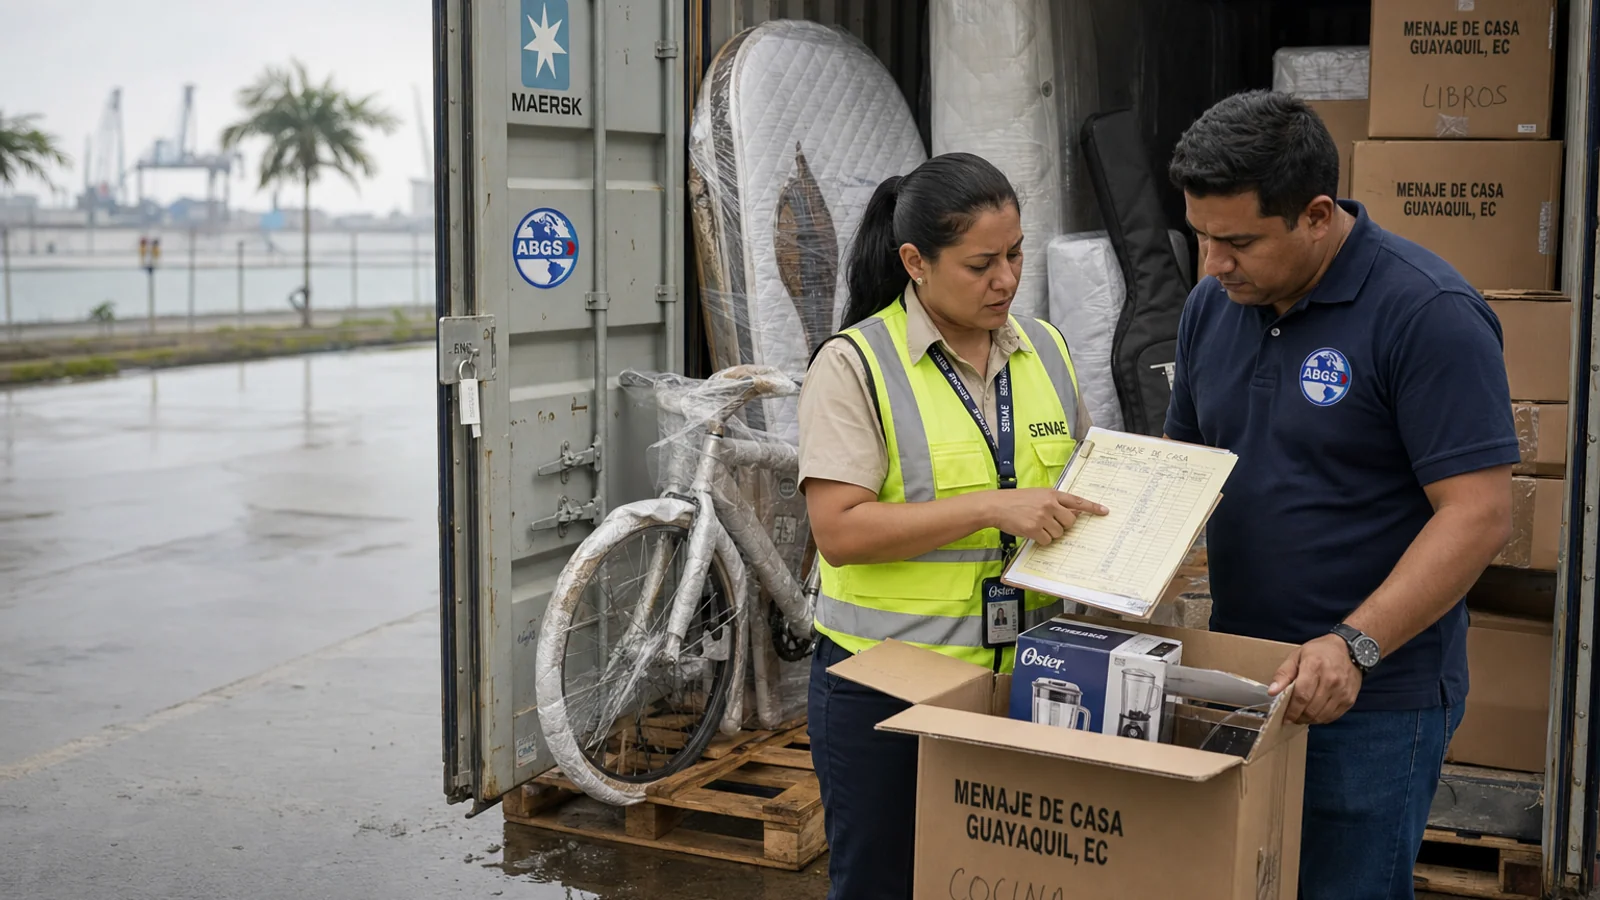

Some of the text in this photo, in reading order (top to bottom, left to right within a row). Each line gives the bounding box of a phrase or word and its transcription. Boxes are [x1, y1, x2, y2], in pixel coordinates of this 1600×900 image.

[1404, 20, 1520, 37] MENAJE DE CASA
[1410, 38, 1510, 57] GUAYAQUIL, EC
[511, 92, 582, 116] MAERSK
[1422, 84, 1508, 110] LIBROS
[1396, 182, 1504, 198] MENAJE DE CASA
[1403, 201, 1496, 220] GUAYAQUIL, EC
[516, 240, 563, 256] ABGS
[1302, 367, 1338, 383] ABGS
[1028, 421, 1068, 438] SENAE
[1021, 647, 1065, 670] Oster
[954, 778, 1124, 838] MENAJE DE CASA
[966, 813, 1109, 866] GUAYAQUIL, EC
